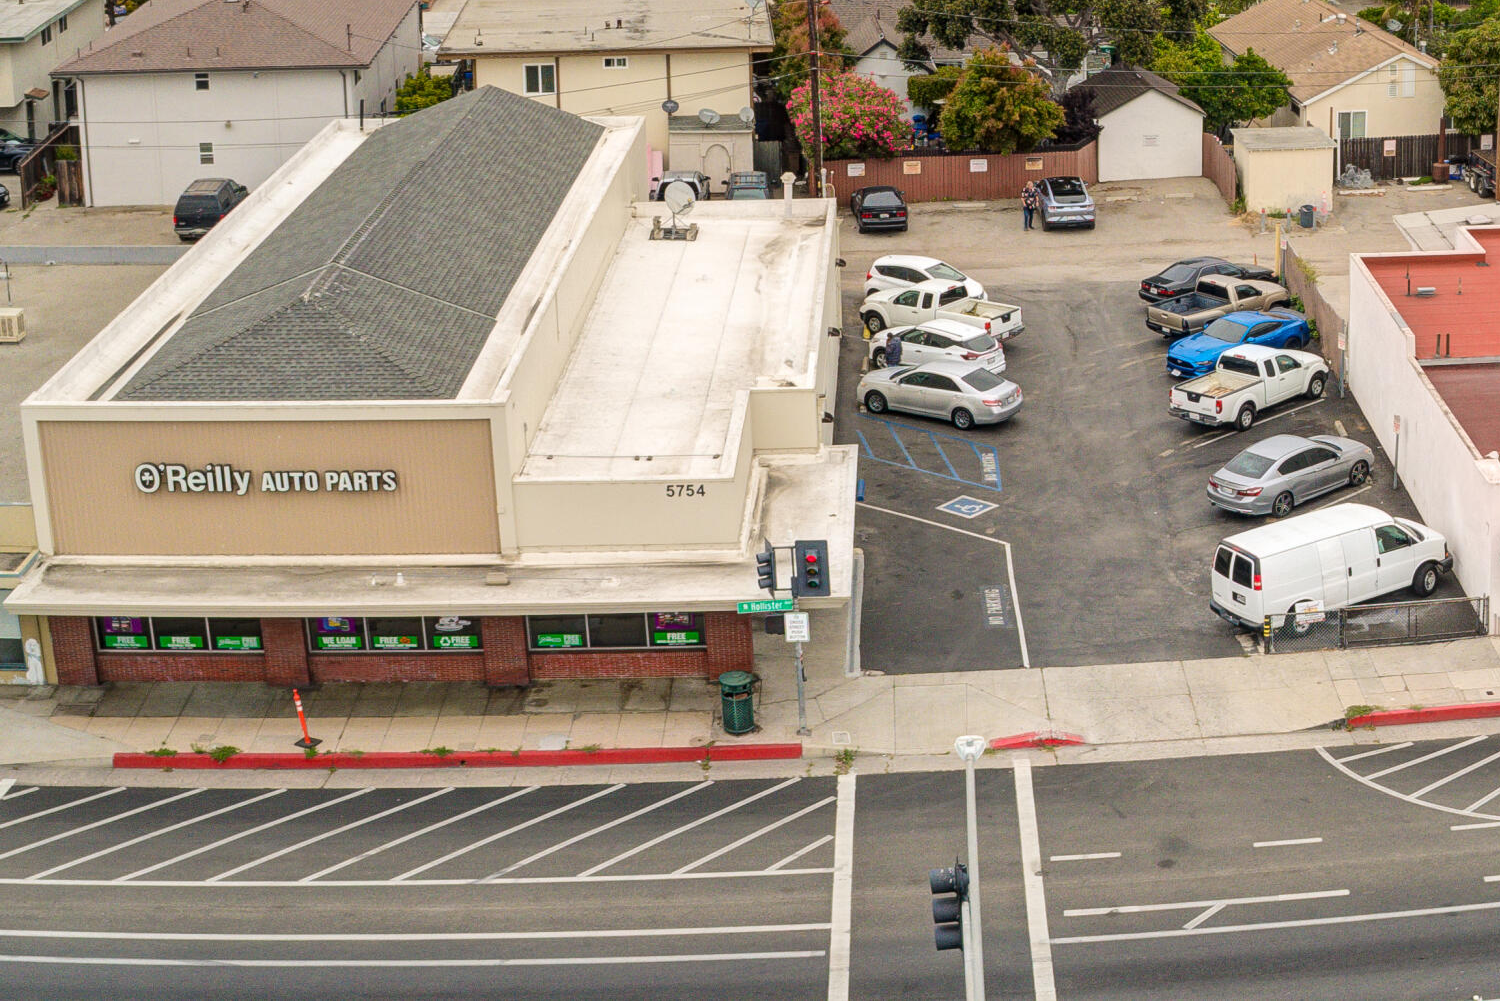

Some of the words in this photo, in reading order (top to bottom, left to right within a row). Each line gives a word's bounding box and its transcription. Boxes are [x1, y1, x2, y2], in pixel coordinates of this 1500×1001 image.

[982, 453, 997, 473] PARKING
[134, 463, 250, 496] O'Reilly
[261, 471, 319, 493] AUTO
[325, 470, 397, 492] PARTS
[666, 484, 706, 498] 5754
[985, 589, 1003, 614] PARKING
[751, 601, 783, 611] Hollister
[989, 616, 1004, 624] NO
[117, 636, 135, 644] FREE
[171, 636, 190, 644] FREE
[322, 636, 336, 644] WE
[337, 636, 356, 644] LOAN
[379, 636, 399, 644] FREE
[451, 636, 470, 644] FREE
[666, 632, 686, 640] FREE
